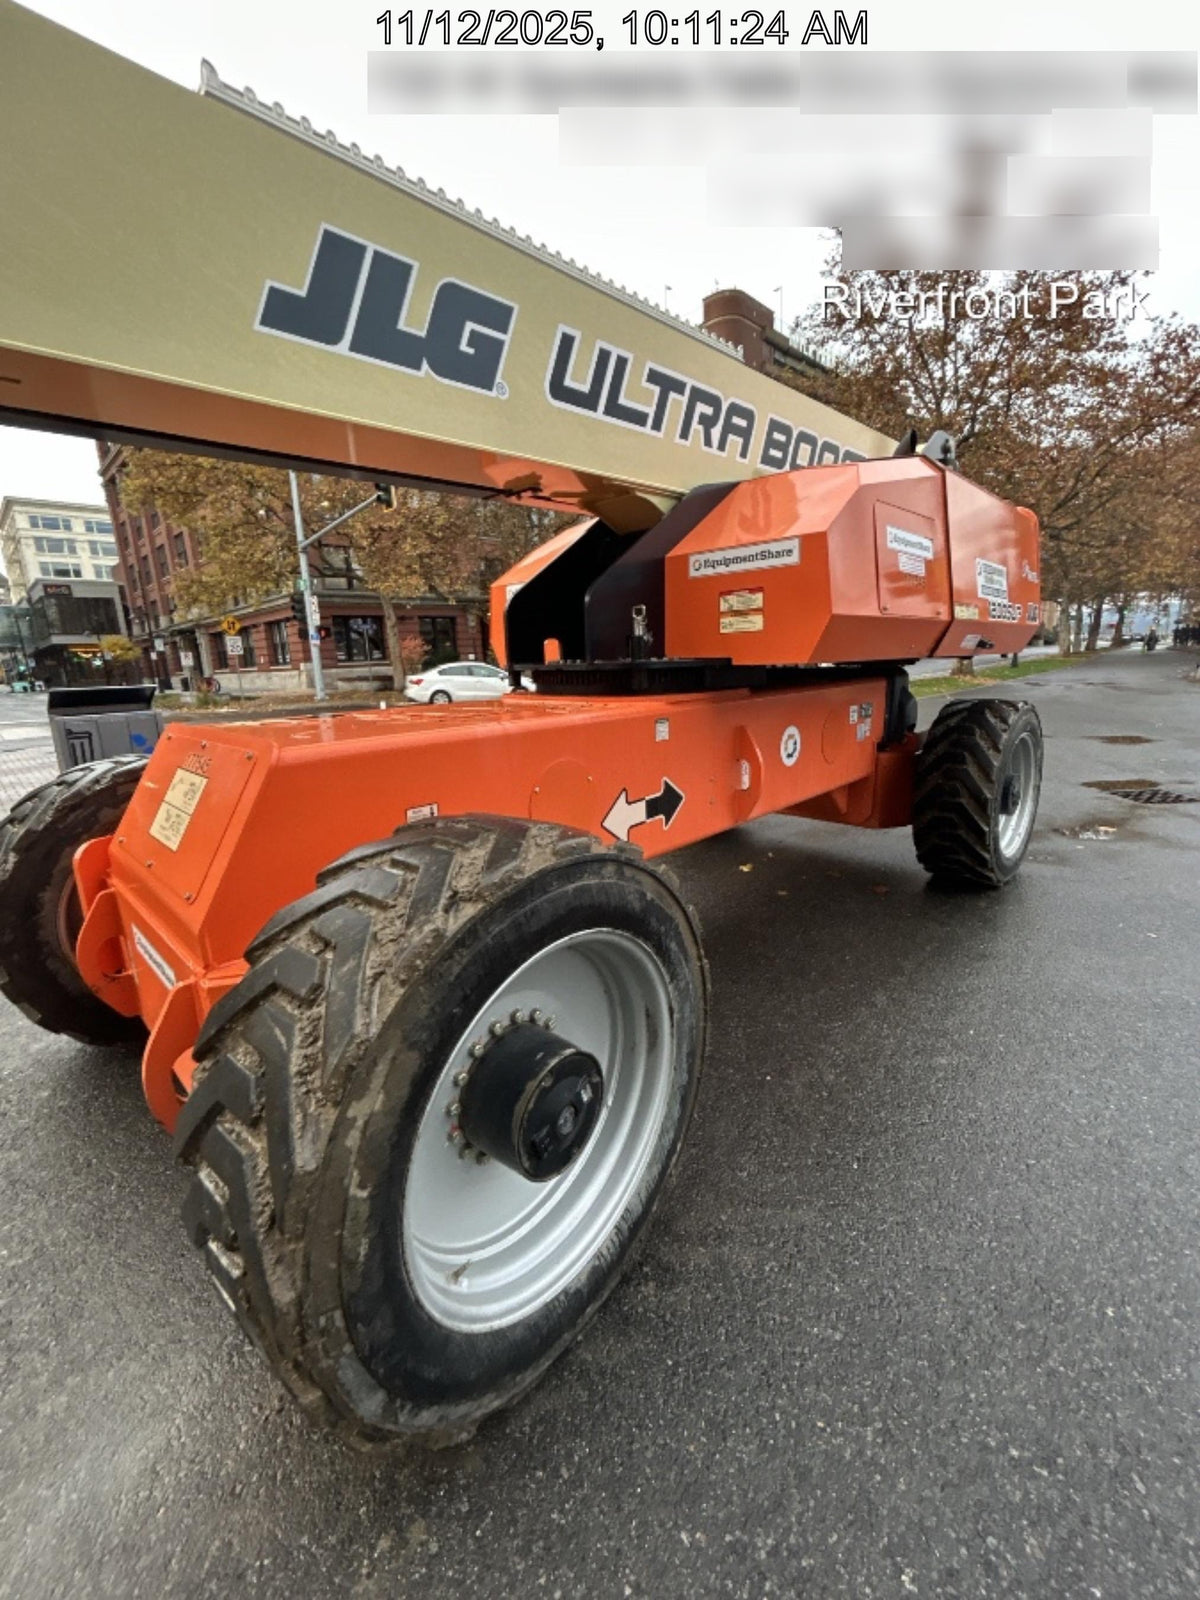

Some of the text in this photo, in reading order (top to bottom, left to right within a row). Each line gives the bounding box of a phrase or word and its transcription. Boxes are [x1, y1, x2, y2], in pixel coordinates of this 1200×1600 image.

[253, 221, 519, 398] JLG
[545, 323, 867, 472] ULTRA BOO
[703, 547, 794, 570] EquipmentShare
